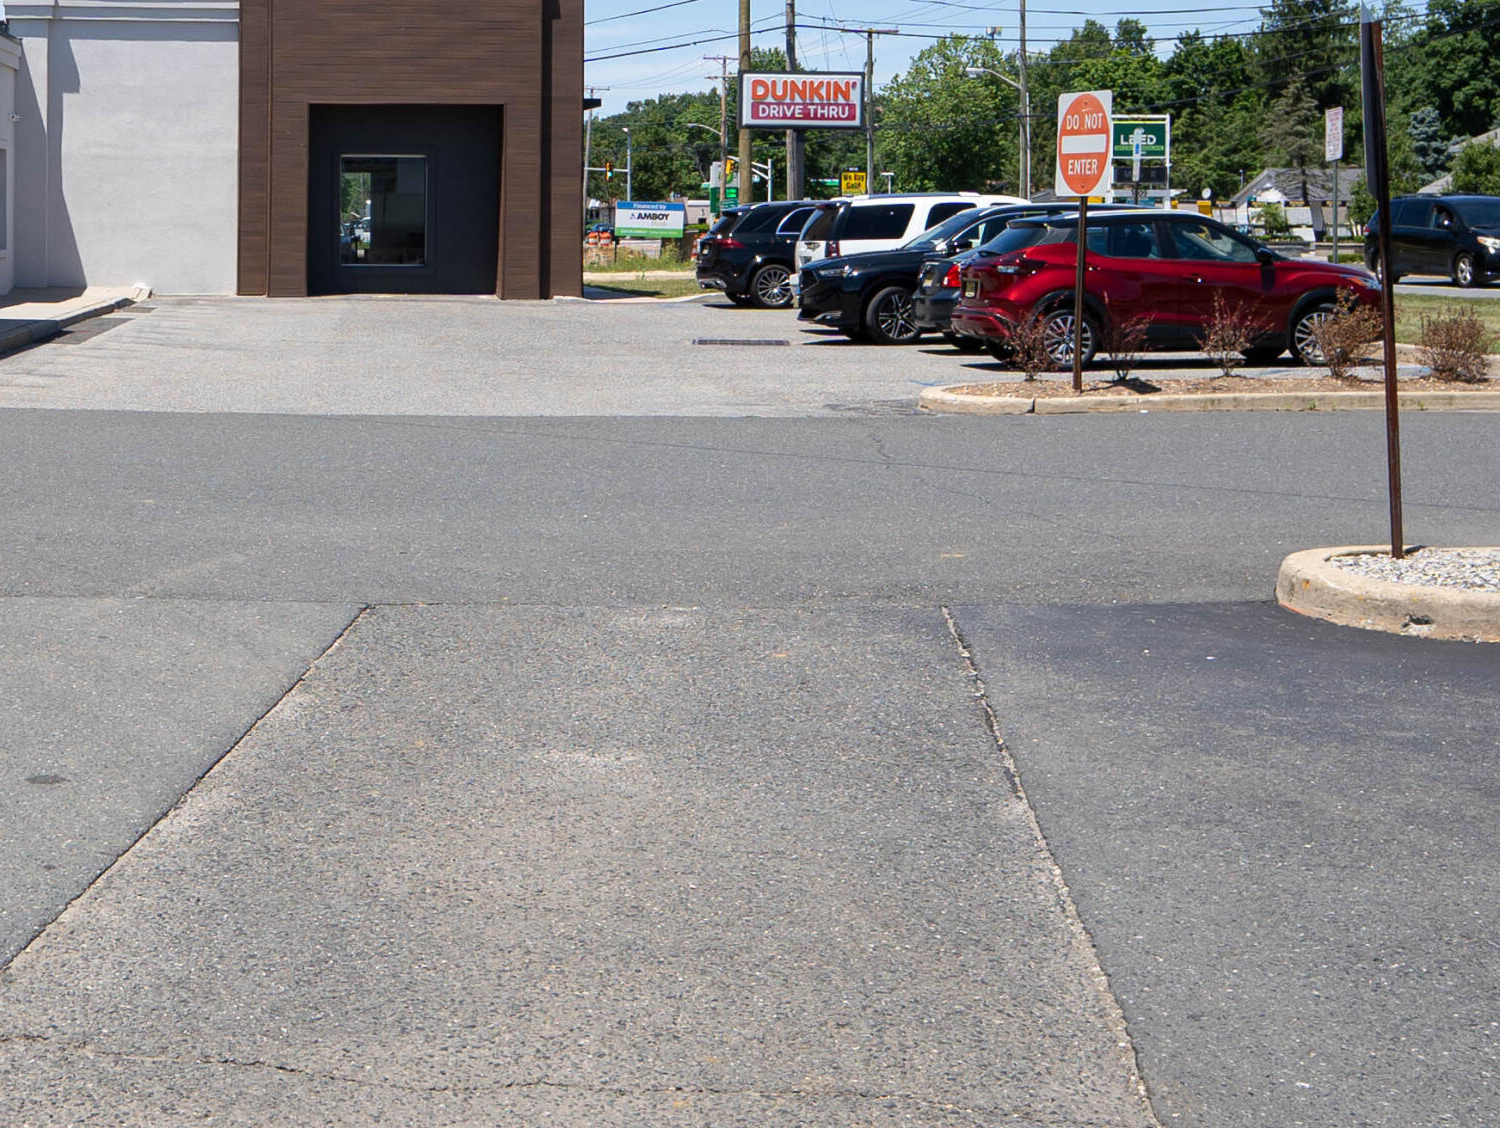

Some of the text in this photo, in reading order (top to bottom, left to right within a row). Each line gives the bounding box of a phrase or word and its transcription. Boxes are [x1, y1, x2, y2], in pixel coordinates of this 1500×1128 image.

[751, 79, 857, 101] DUNKIN'
[758, 104, 849, 118] DRIVE THRU
[1066, 112, 1103, 130] DO NOT
[1068, 159, 1098, 175] ENTER
[637, 213, 670, 222] AMBOY
